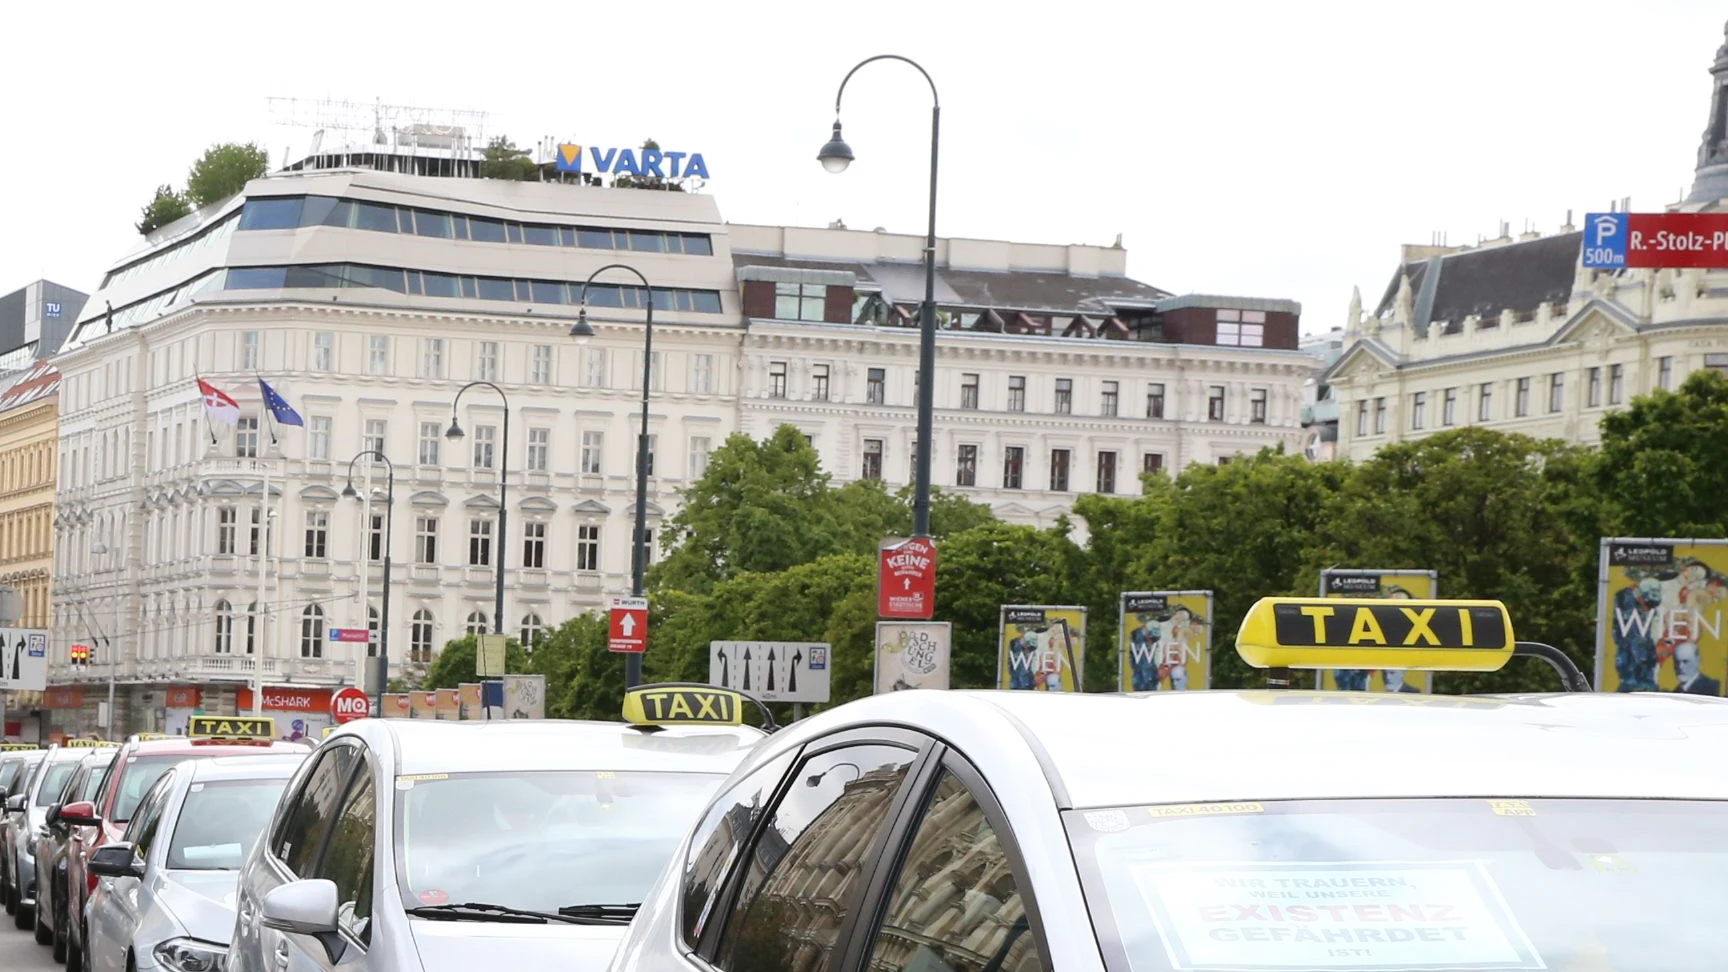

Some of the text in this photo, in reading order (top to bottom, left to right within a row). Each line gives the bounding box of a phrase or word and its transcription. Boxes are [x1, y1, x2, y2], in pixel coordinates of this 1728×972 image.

[590, 146, 710, 179] VARTA
[46, 303, 60, 313] TU
[887, 554, 930, 569] KEINE
[1300, 605, 1474, 646] TAXI
[1615, 607, 1721, 641] WIEN
[1131, 642, 1201, 664] WIEN
[1010, 651, 1072, 673] WIEN
[262, 696, 311, 707] McSHARK
[337, 697, 367, 713] MQ
[646, 693, 729, 720] TAXI
[201, 722, 263, 734] TAXI
[1153, 803, 1258, 816] TAXI 40 100
[1504, 808, 1536, 816] APP
[1213, 877, 1417, 890] WIR TRAUERN,
[1249, 889, 1392, 899] WEIL UNSERE
[1199, 904, 1464, 923] EXISTENZ
[1208, 924, 1469, 944] GEFÄHRDET
[1327, 948, 1372, 957] IST!
